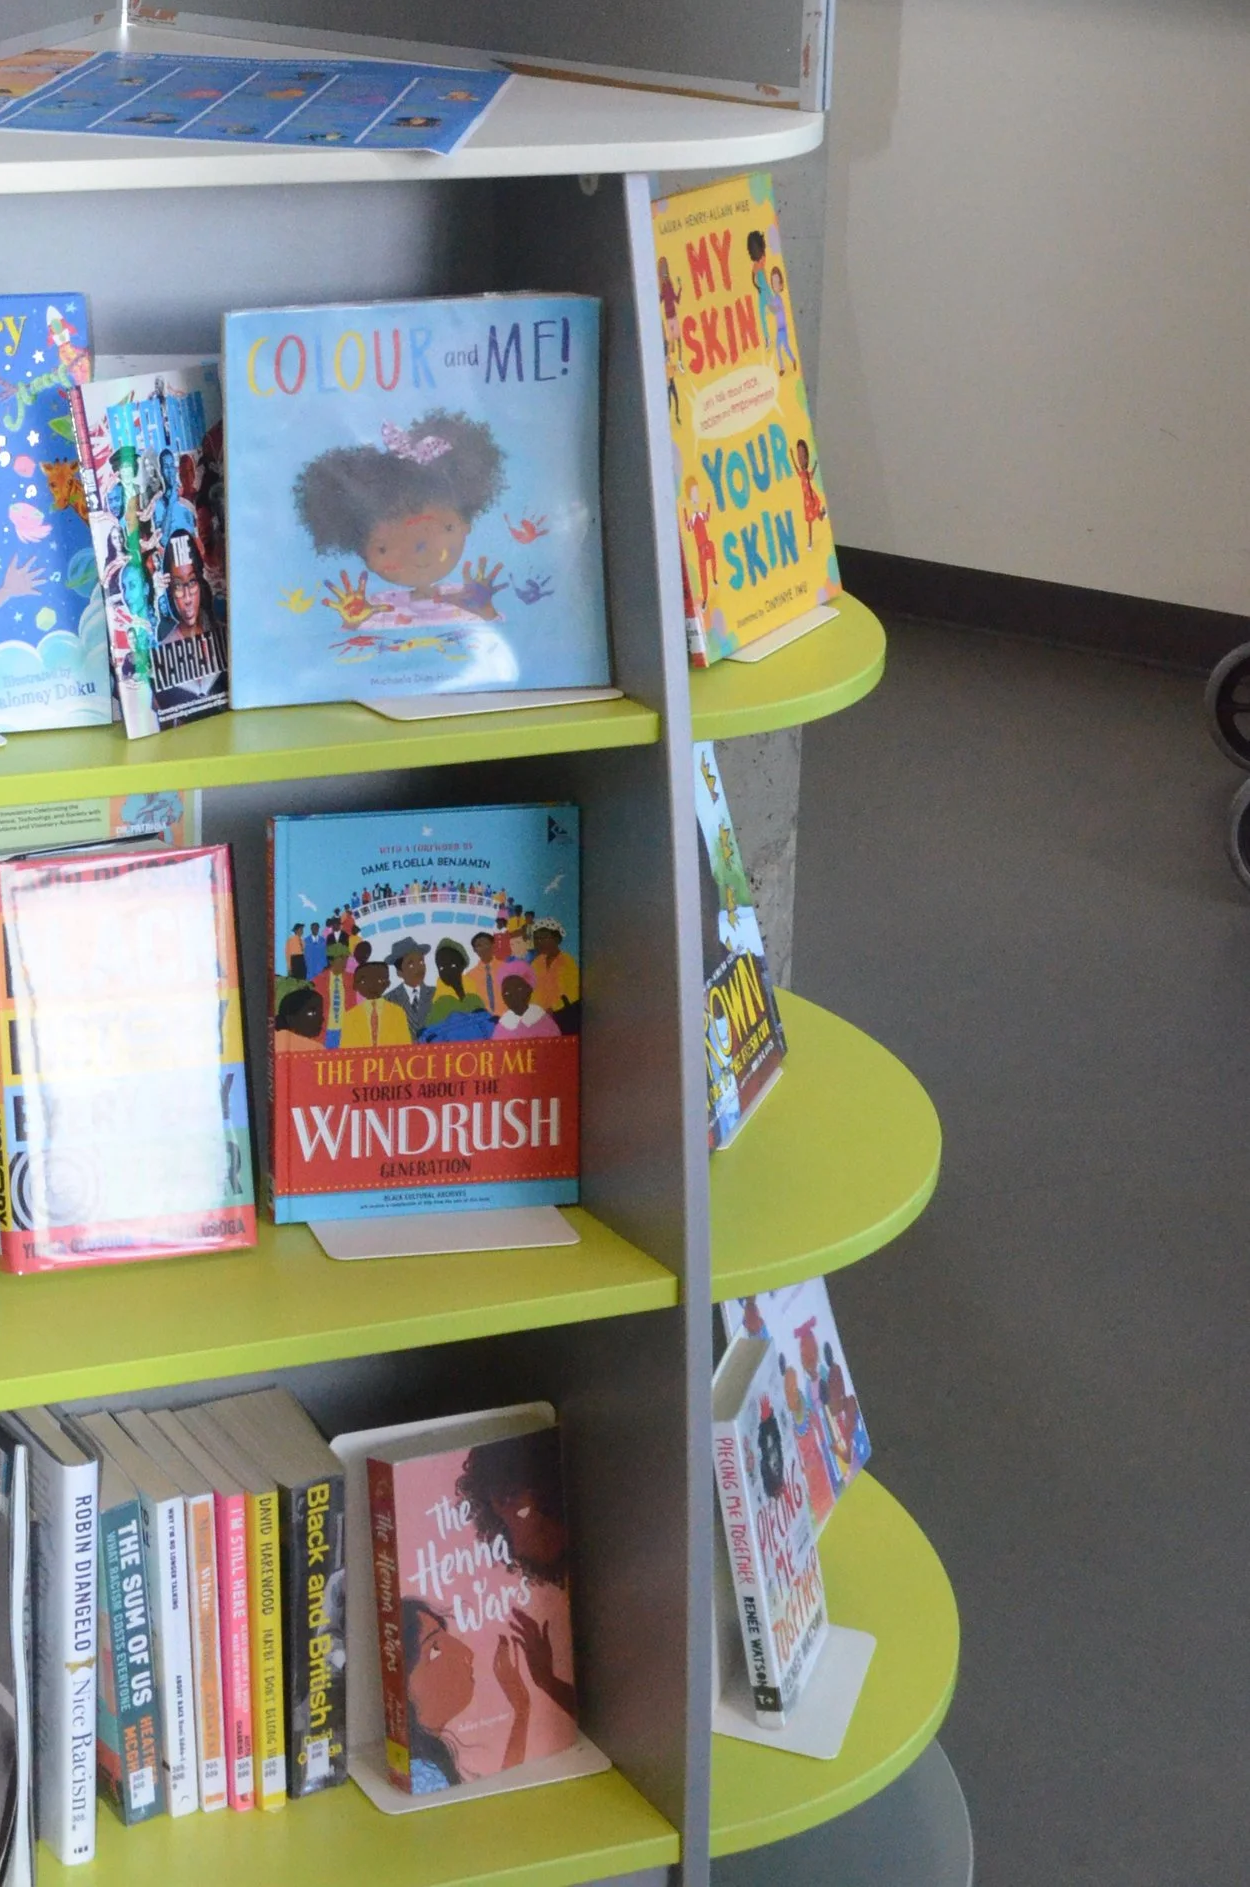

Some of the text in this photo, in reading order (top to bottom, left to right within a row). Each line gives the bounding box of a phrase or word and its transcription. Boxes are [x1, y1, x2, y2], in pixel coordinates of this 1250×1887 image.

[685, 228, 732, 301] MY
[246, 317, 571, 397] COLOUR and ME!
[682, 294, 760, 375] SKIN
[702, 422, 793, 512] YOUR
[170, 534, 193, 567] THE
[722, 508, 799, 591] SKIN
[55, 680, 96, 701] Doku
[361, 856, 491, 876] DAME FLOELLA BENJAMIN
[314, 1047, 537, 1087] THE PLACE FOR ME
[351, 1078, 500, 1104] STORIES ABOUT THE
[291, 1097, 562, 1163] WINDRUSH
[380, 1158, 472, 1179] GENERATION
[404, 1189, 467, 1201] CULTURAL ARCHIVES
[230, 1507, 245, 1529] I'M
[425, 1494, 473, 1540] The
[756, 1460, 804, 1574] PIECING
[73, 1495, 93, 1653] ROBIN DIANGELO
[170, 1552, 180, 1611] LONGER TALKING
[231, 1535, 245, 1577] STILL
[260, 1497, 275, 1617] DAVID HAREWOOD
[407, 1533, 513, 1602] Henna
[715, 1437, 771, 1689] PIECING ME TOGETHER RENÉE WATSON
[775, 1539, 795, 1592] ME
[117, 1519, 153, 1716] THE SUM OF US
[199, 1566, 212, 1612] White
[232, 1579, 247, 1619] HERE
[306, 1483, 332, 1729] Black and British
[374, 1511, 399, 1672] The Henna Wars
[453, 1575, 533, 1634] Wars
[770, 1544, 822, 1674] TOGETHER
[105, 1530, 131, 1714] WHAT RACISM COSTS EVERYONE
[262, 1628, 275, 1665] MAYBE
[71, 1679, 93, 1729] Nice
[266, 1707, 278, 1746] BELONG
